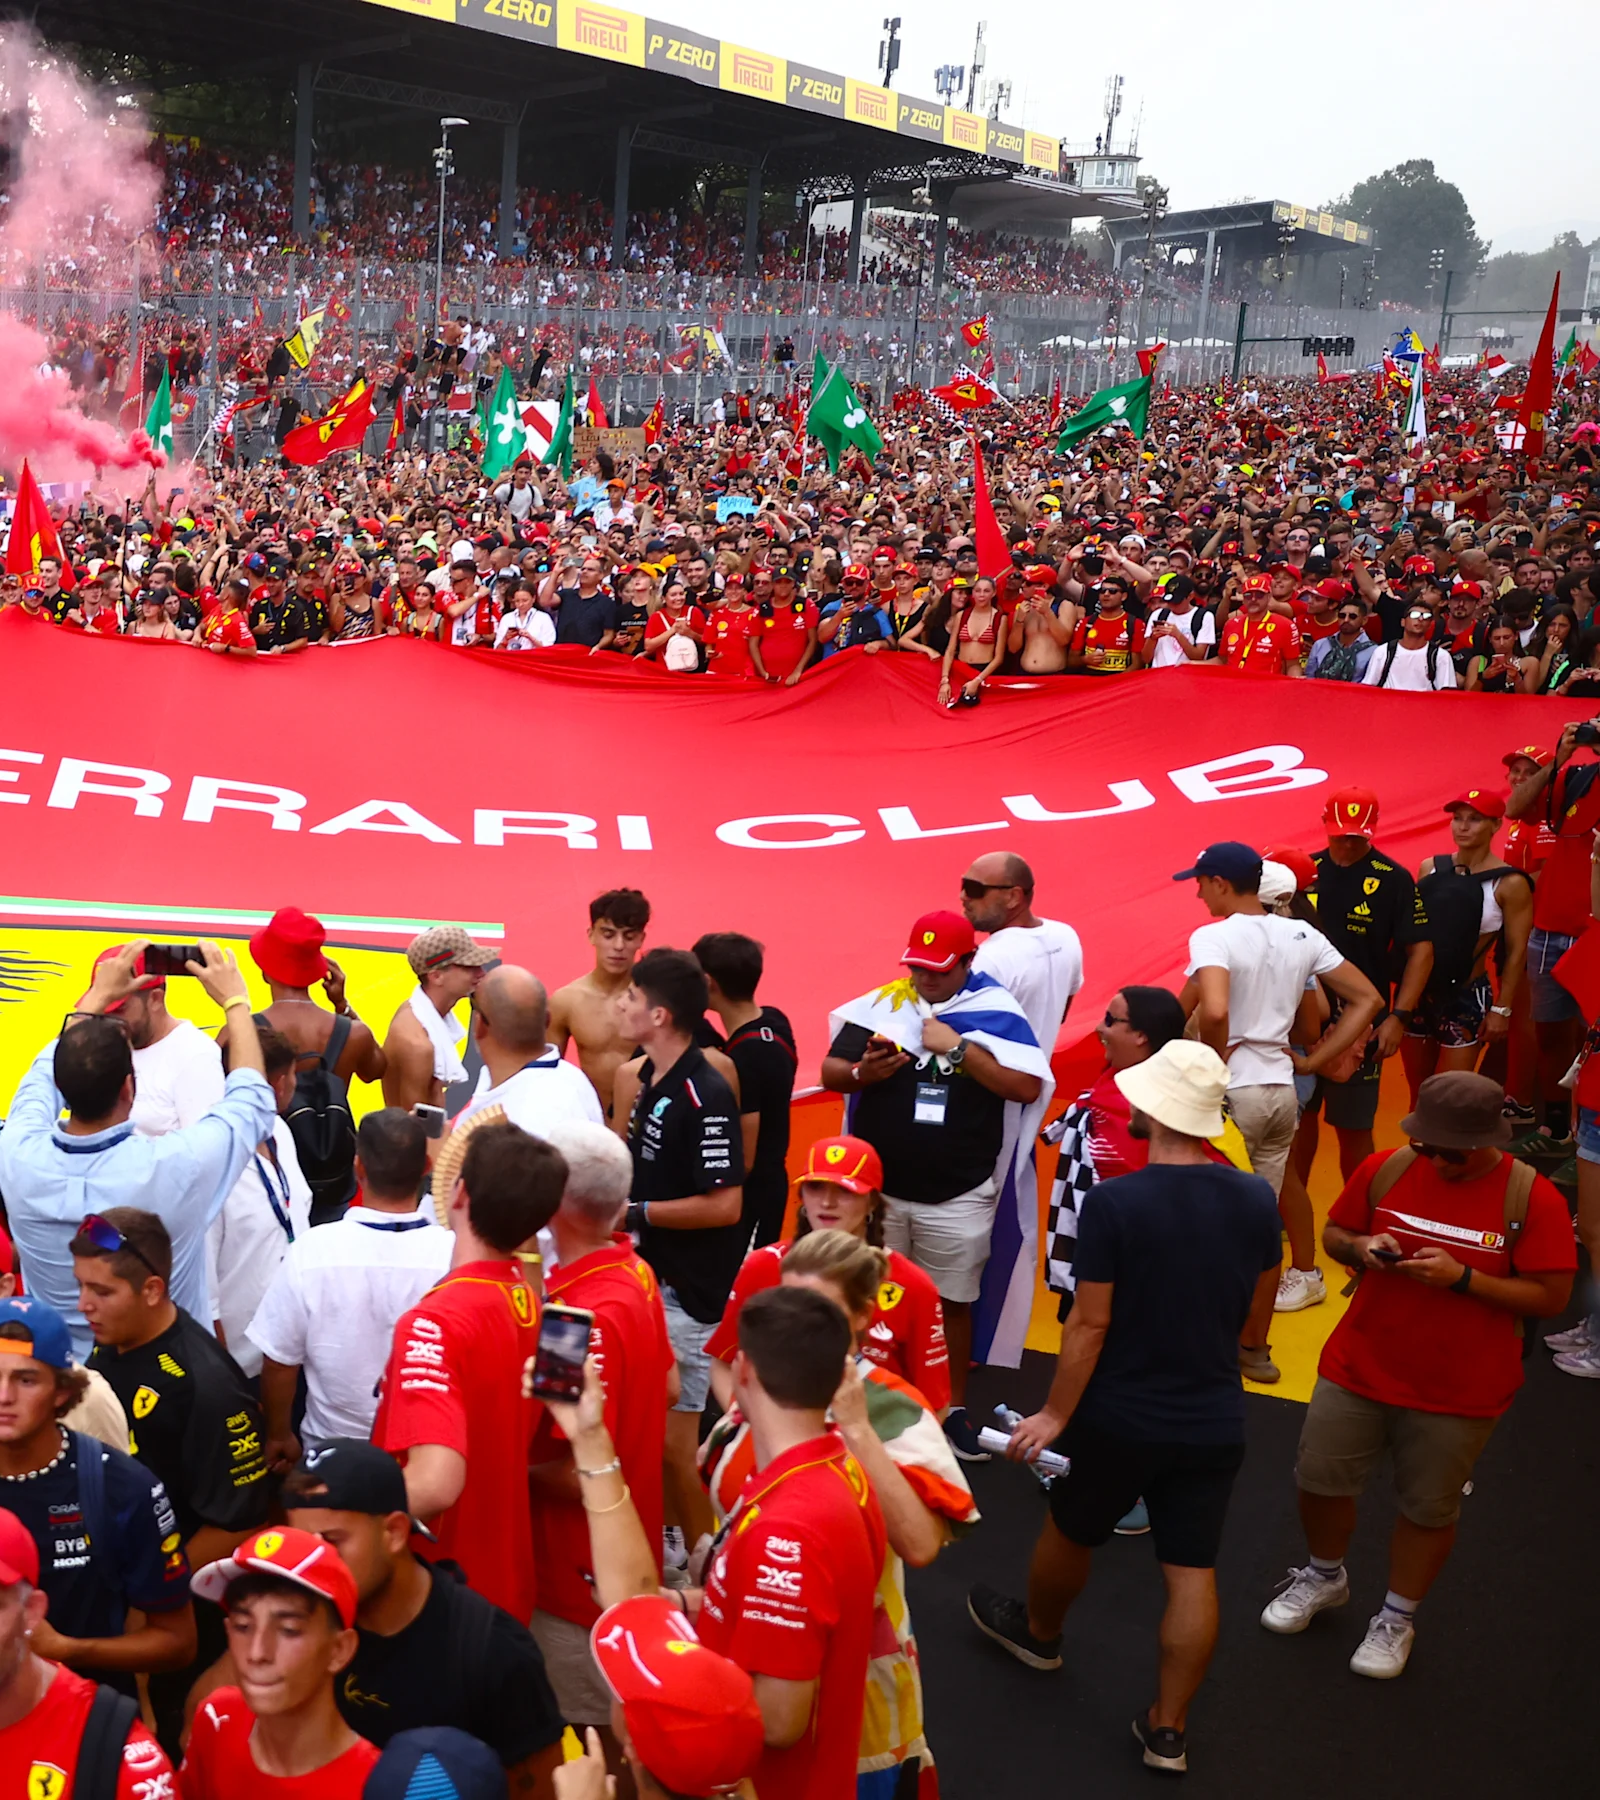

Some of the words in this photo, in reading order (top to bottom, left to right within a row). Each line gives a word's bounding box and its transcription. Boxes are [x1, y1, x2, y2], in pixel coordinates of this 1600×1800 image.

[483, 0, 553, 28] ZERO
[575, 7, 628, 54] PIRELLI
[649, 34, 664, 55] P
[665, 38, 717, 72] ZERO
[733, 52, 773, 93] PIRELLI
[789, 74, 802, 93] P
[802, 78, 843, 105] ZERO
[855, 86, 887, 122] PIRELLI
[899, 105, 910, 122] P
[910, 108, 943, 132] ZERO
[952, 114, 979, 145] PIRELLI
[988, 129, 996, 145] P
[995, 131, 1023, 152] ZERO
[1031, 137, 1052, 165] PIRELLI
[715, 743, 1330, 850] CLUB
[412, 1317, 442, 1333] aws
[226, 1411, 249, 1428] aws
[229, 1431, 260, 1456] DXC
[765, 1535, 802, 1555] aws
[756, 1564, 803, 1591] DXC
[122, 1740, 158, 1760] aws
